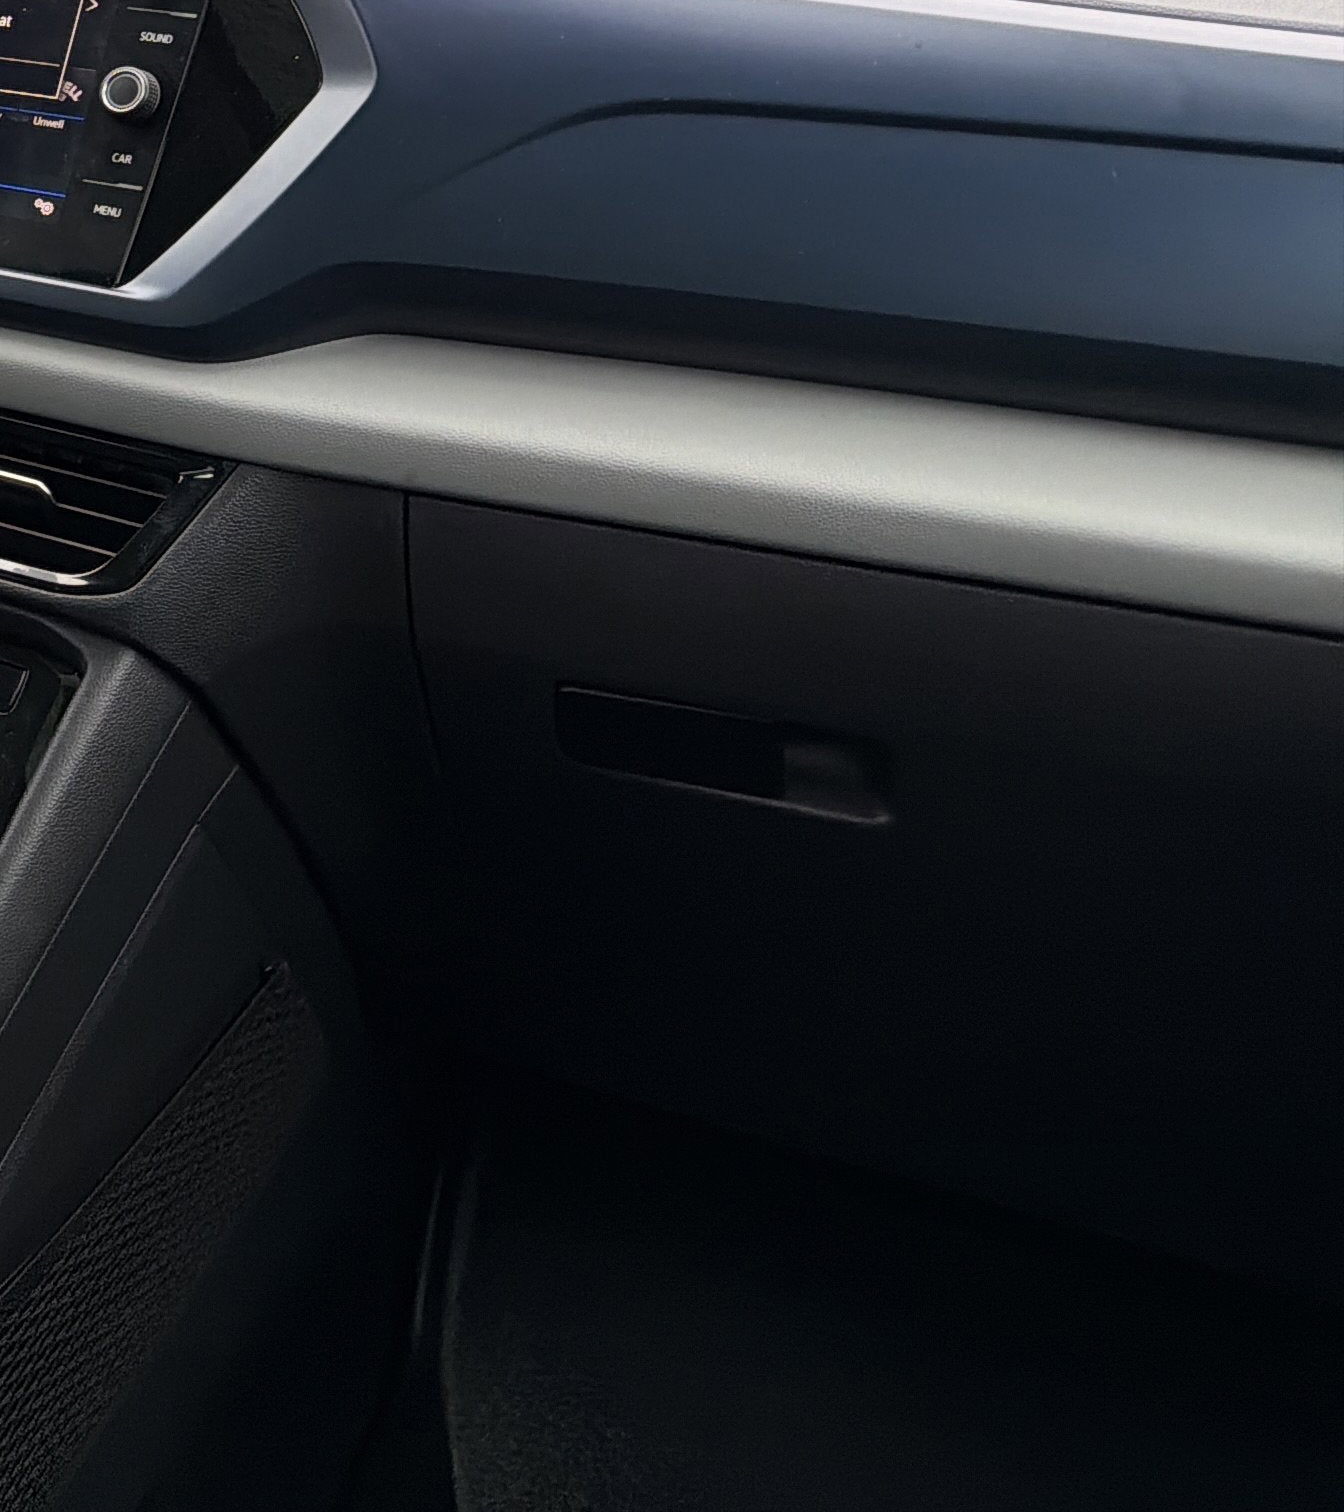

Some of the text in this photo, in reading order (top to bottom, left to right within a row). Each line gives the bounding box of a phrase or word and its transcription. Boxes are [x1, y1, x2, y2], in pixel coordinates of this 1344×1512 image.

[139, 31, 174, 44] SOUND
[32, 116, 66, 130] Unwell
[112, 152, 133, 164] CAR
[93, 203, 122, 218] MENU
